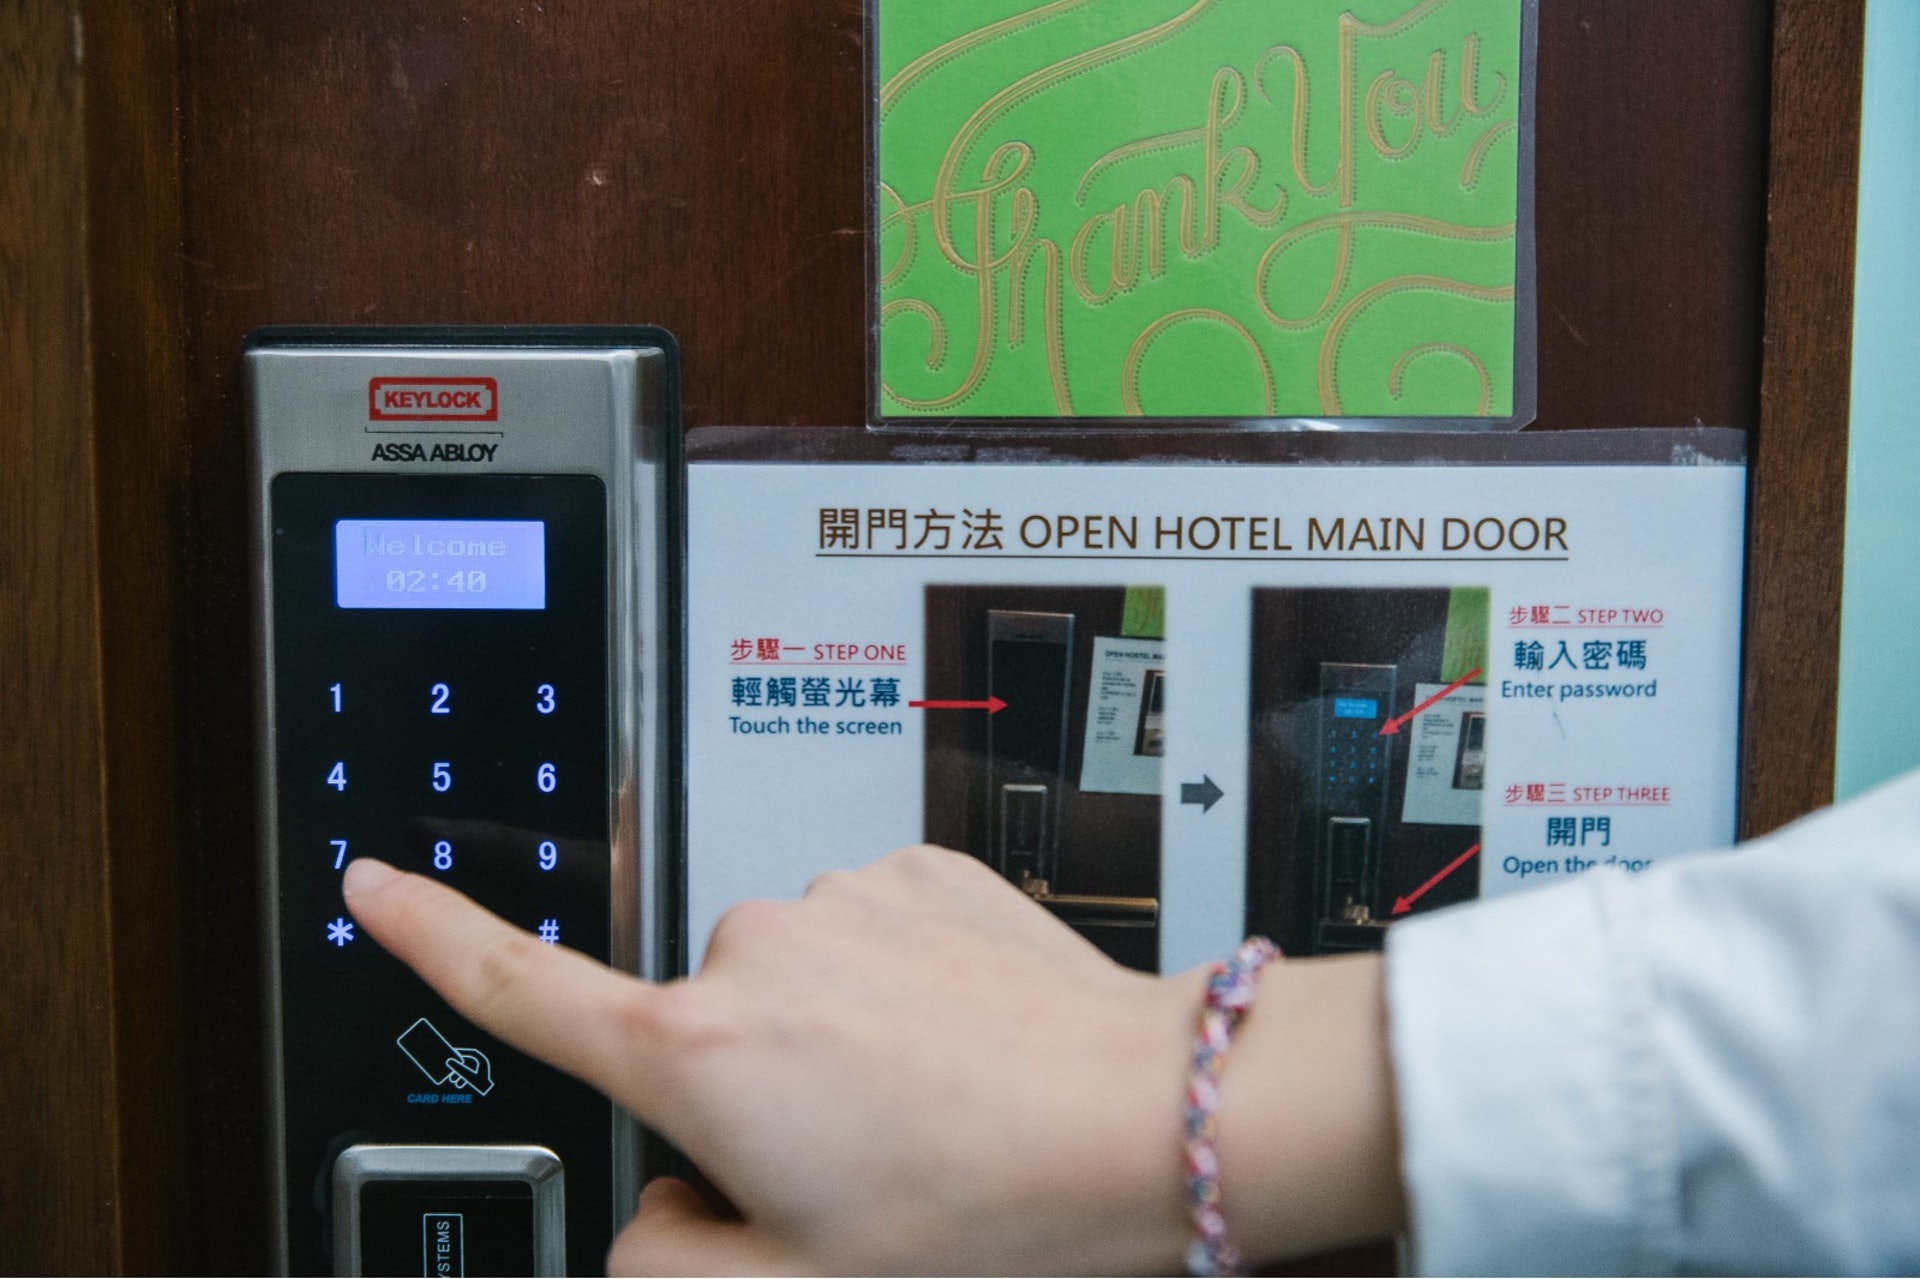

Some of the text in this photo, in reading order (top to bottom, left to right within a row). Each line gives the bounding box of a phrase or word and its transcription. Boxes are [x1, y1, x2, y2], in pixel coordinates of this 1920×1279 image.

[1253, 10, 1510, 331] You
[383, 390, 482, 409] KEYLOCK
[371, 443, 499, 463] ASSA ABLOY
[818, 508, 1569, 552] 開門方法 OPEN HOTEL MAIN DOOR
[363, 531, 508, 557] Welcome
[384, 570, 487, 593] 02:40
[1509, 605, 1664, 625] 步驟二 STEP TWO
[730, 638, 906, 661] 步驟一 STEP ONE
[1514, 639, 1647, 671] 輸入密碼
[329, 682, 556, 714] 1 2 3
[731, 676, 900, 708] 輕觸螢光幕
[1501, 679, 1657, 702] Enter password
[729, 715, 903, 735] Touch the screen
[326, 761, 557, 793] 4 5 6
[1505, 784, 1671, 803] 步驟三 STEP THREE
[1547, 816, 1611, 847] 開門
[330, 839, 557, 871] 7 8 9
[1503, 856, 1559, 878] Open
[407, 1094, 473, 1104] CARD HERE
